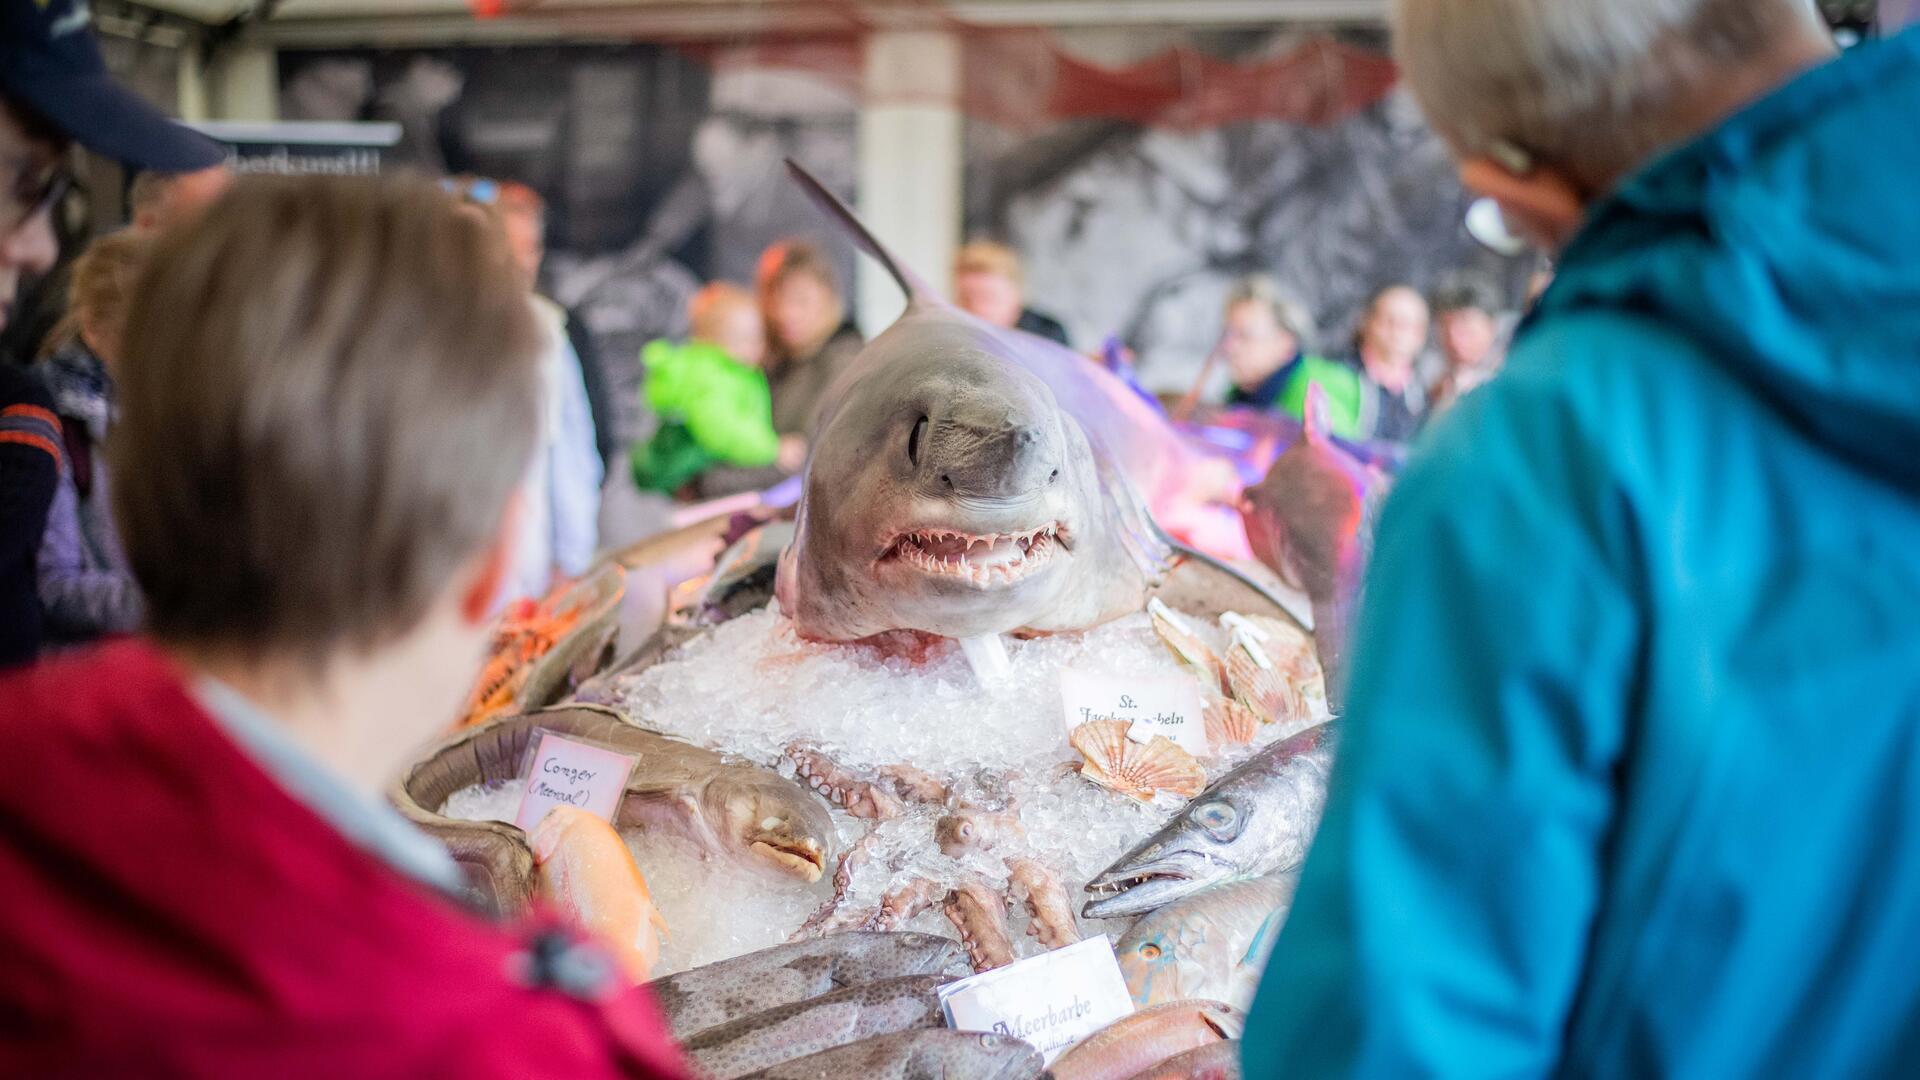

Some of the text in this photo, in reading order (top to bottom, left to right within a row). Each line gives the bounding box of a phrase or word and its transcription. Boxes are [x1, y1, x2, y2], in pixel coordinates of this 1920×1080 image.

[1119, 694, 1138, 709] St.
[543, 757, 597, 785] Conger
[992, 994, 1092, 1039] Meerbarbe
